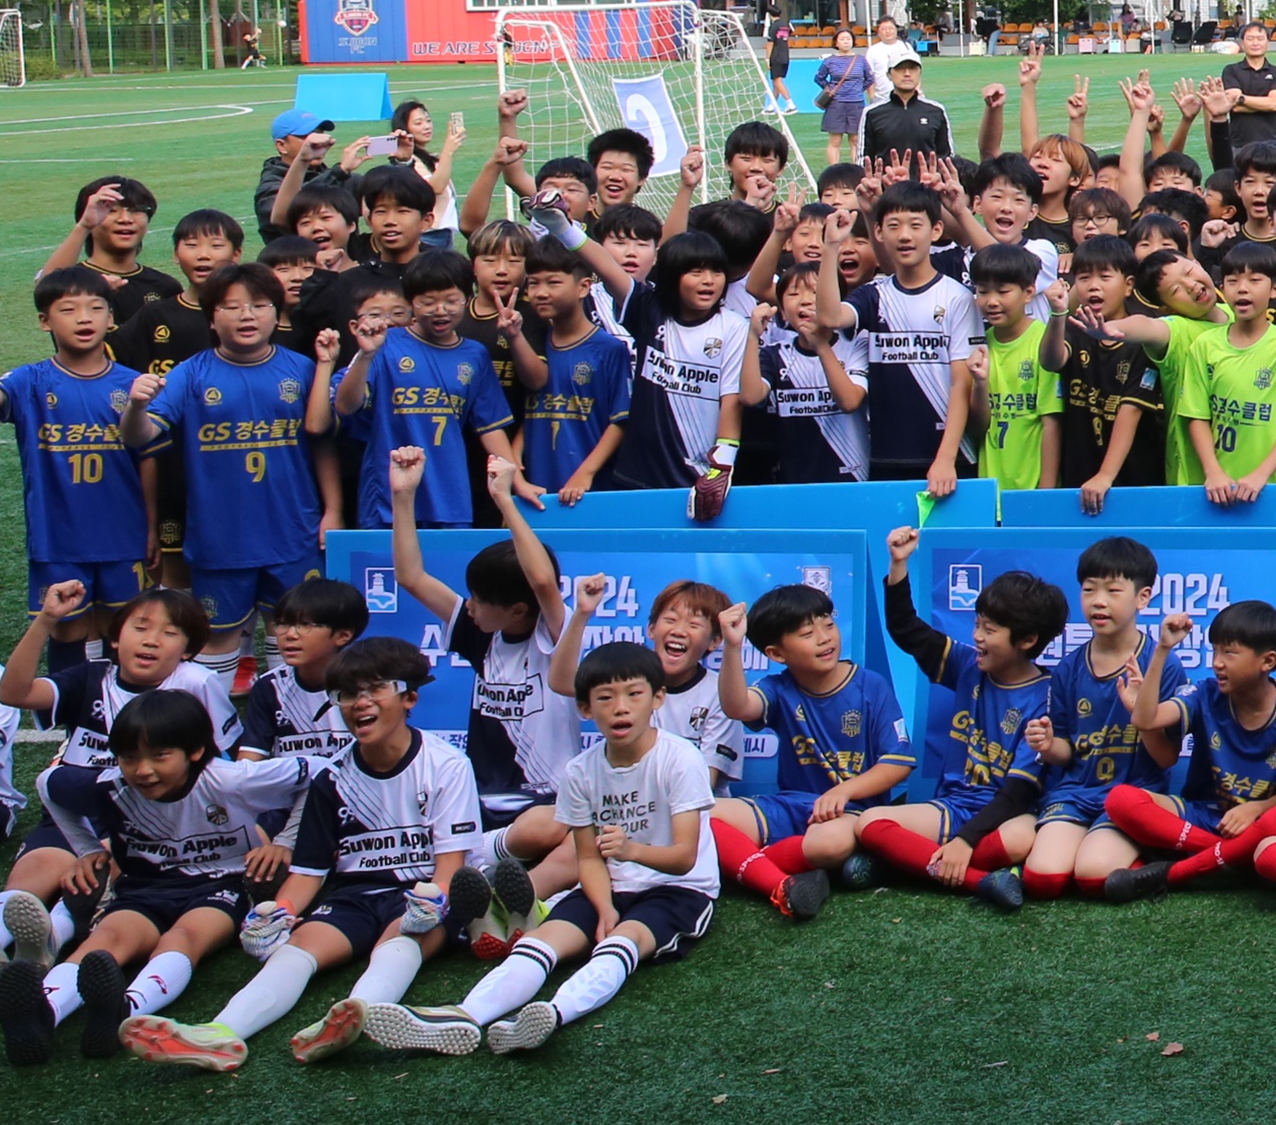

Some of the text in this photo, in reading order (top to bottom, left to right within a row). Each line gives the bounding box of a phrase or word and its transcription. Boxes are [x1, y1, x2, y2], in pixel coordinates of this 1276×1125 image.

[412, 42, 439, 56] WE
[441, 42, 480, 55] ARE
[678, 366, 719, 384] Apple
[392, 386, 421, 406] GS
[681, 382, 702, 394] Club
[777, 390, 815, 404] Suwon
[38, 422, 123, 443] GS 경수클
[197, 417, 303, 443] GS 경수클럽
[431, 416, 448, 447] 7
[997, 421, 1009, 449] 7
[69, 453, 105, 484] 10
[244, 451, 267, 483] 9
[1142, 573, 1231, 617] 2024
[601, 790, 639, 807] MAKE
[182, 832, 238, 854] Apple
[338, 835, 396, 856] Suwon
[358, 852, 407, 870] Football
